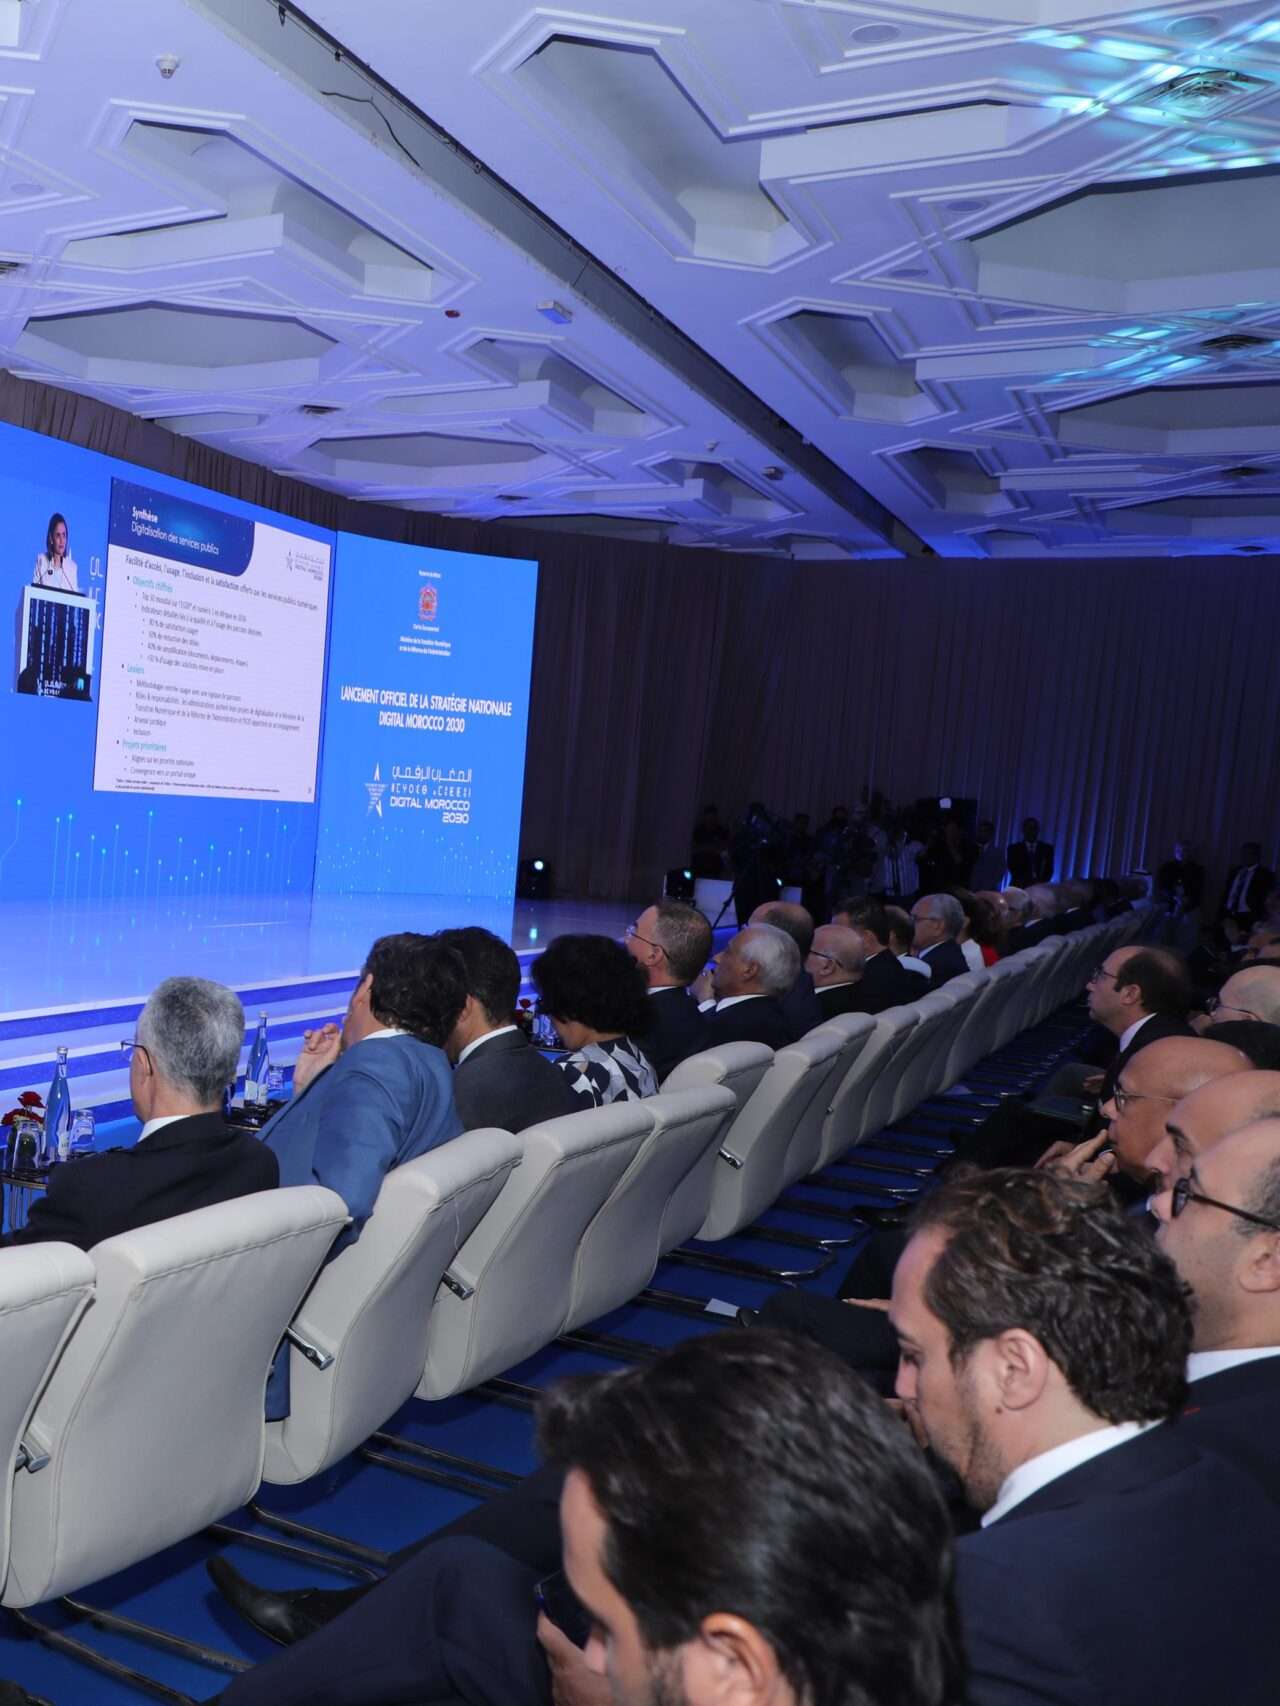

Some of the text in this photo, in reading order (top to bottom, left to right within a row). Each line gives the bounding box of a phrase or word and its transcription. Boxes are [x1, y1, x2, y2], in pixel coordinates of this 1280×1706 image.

[341, 686, 512, 716] LANCEMENT OFFICIEL DE LA STRATÉGIE NATIONALE
[379, 711, 465, 733] DIGITAL MOROCCO 2030
[390, 796, 470, 812] DIGITAL MOROCCO
[442, 812, 469, 824] 2030
